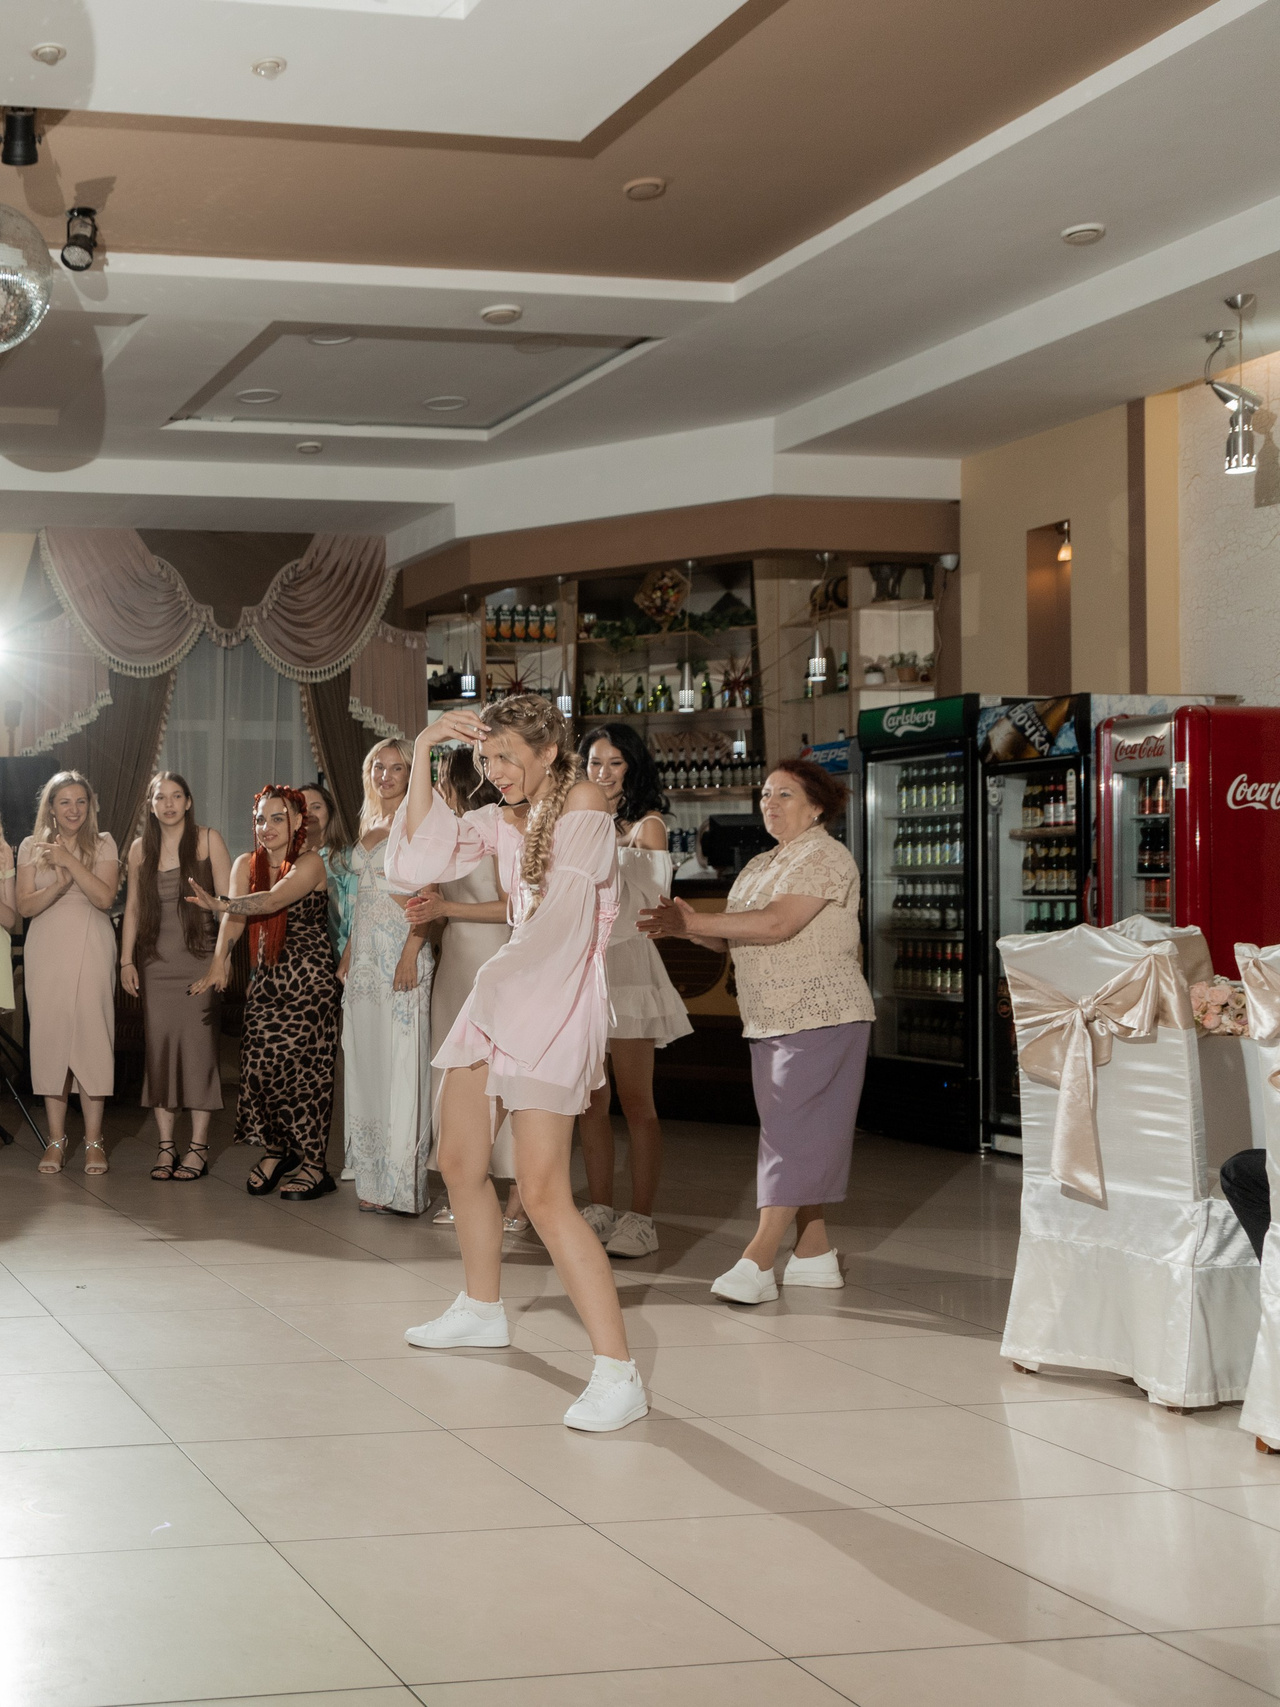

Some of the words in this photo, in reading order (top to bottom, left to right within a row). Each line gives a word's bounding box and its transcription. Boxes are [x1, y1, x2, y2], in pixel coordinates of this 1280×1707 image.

[883, 707, 936, 737] Carlsberg
[1008, 703, 1050, 756] БОЧКА
[1115, 735, 1166, 762] Coca-Cola
